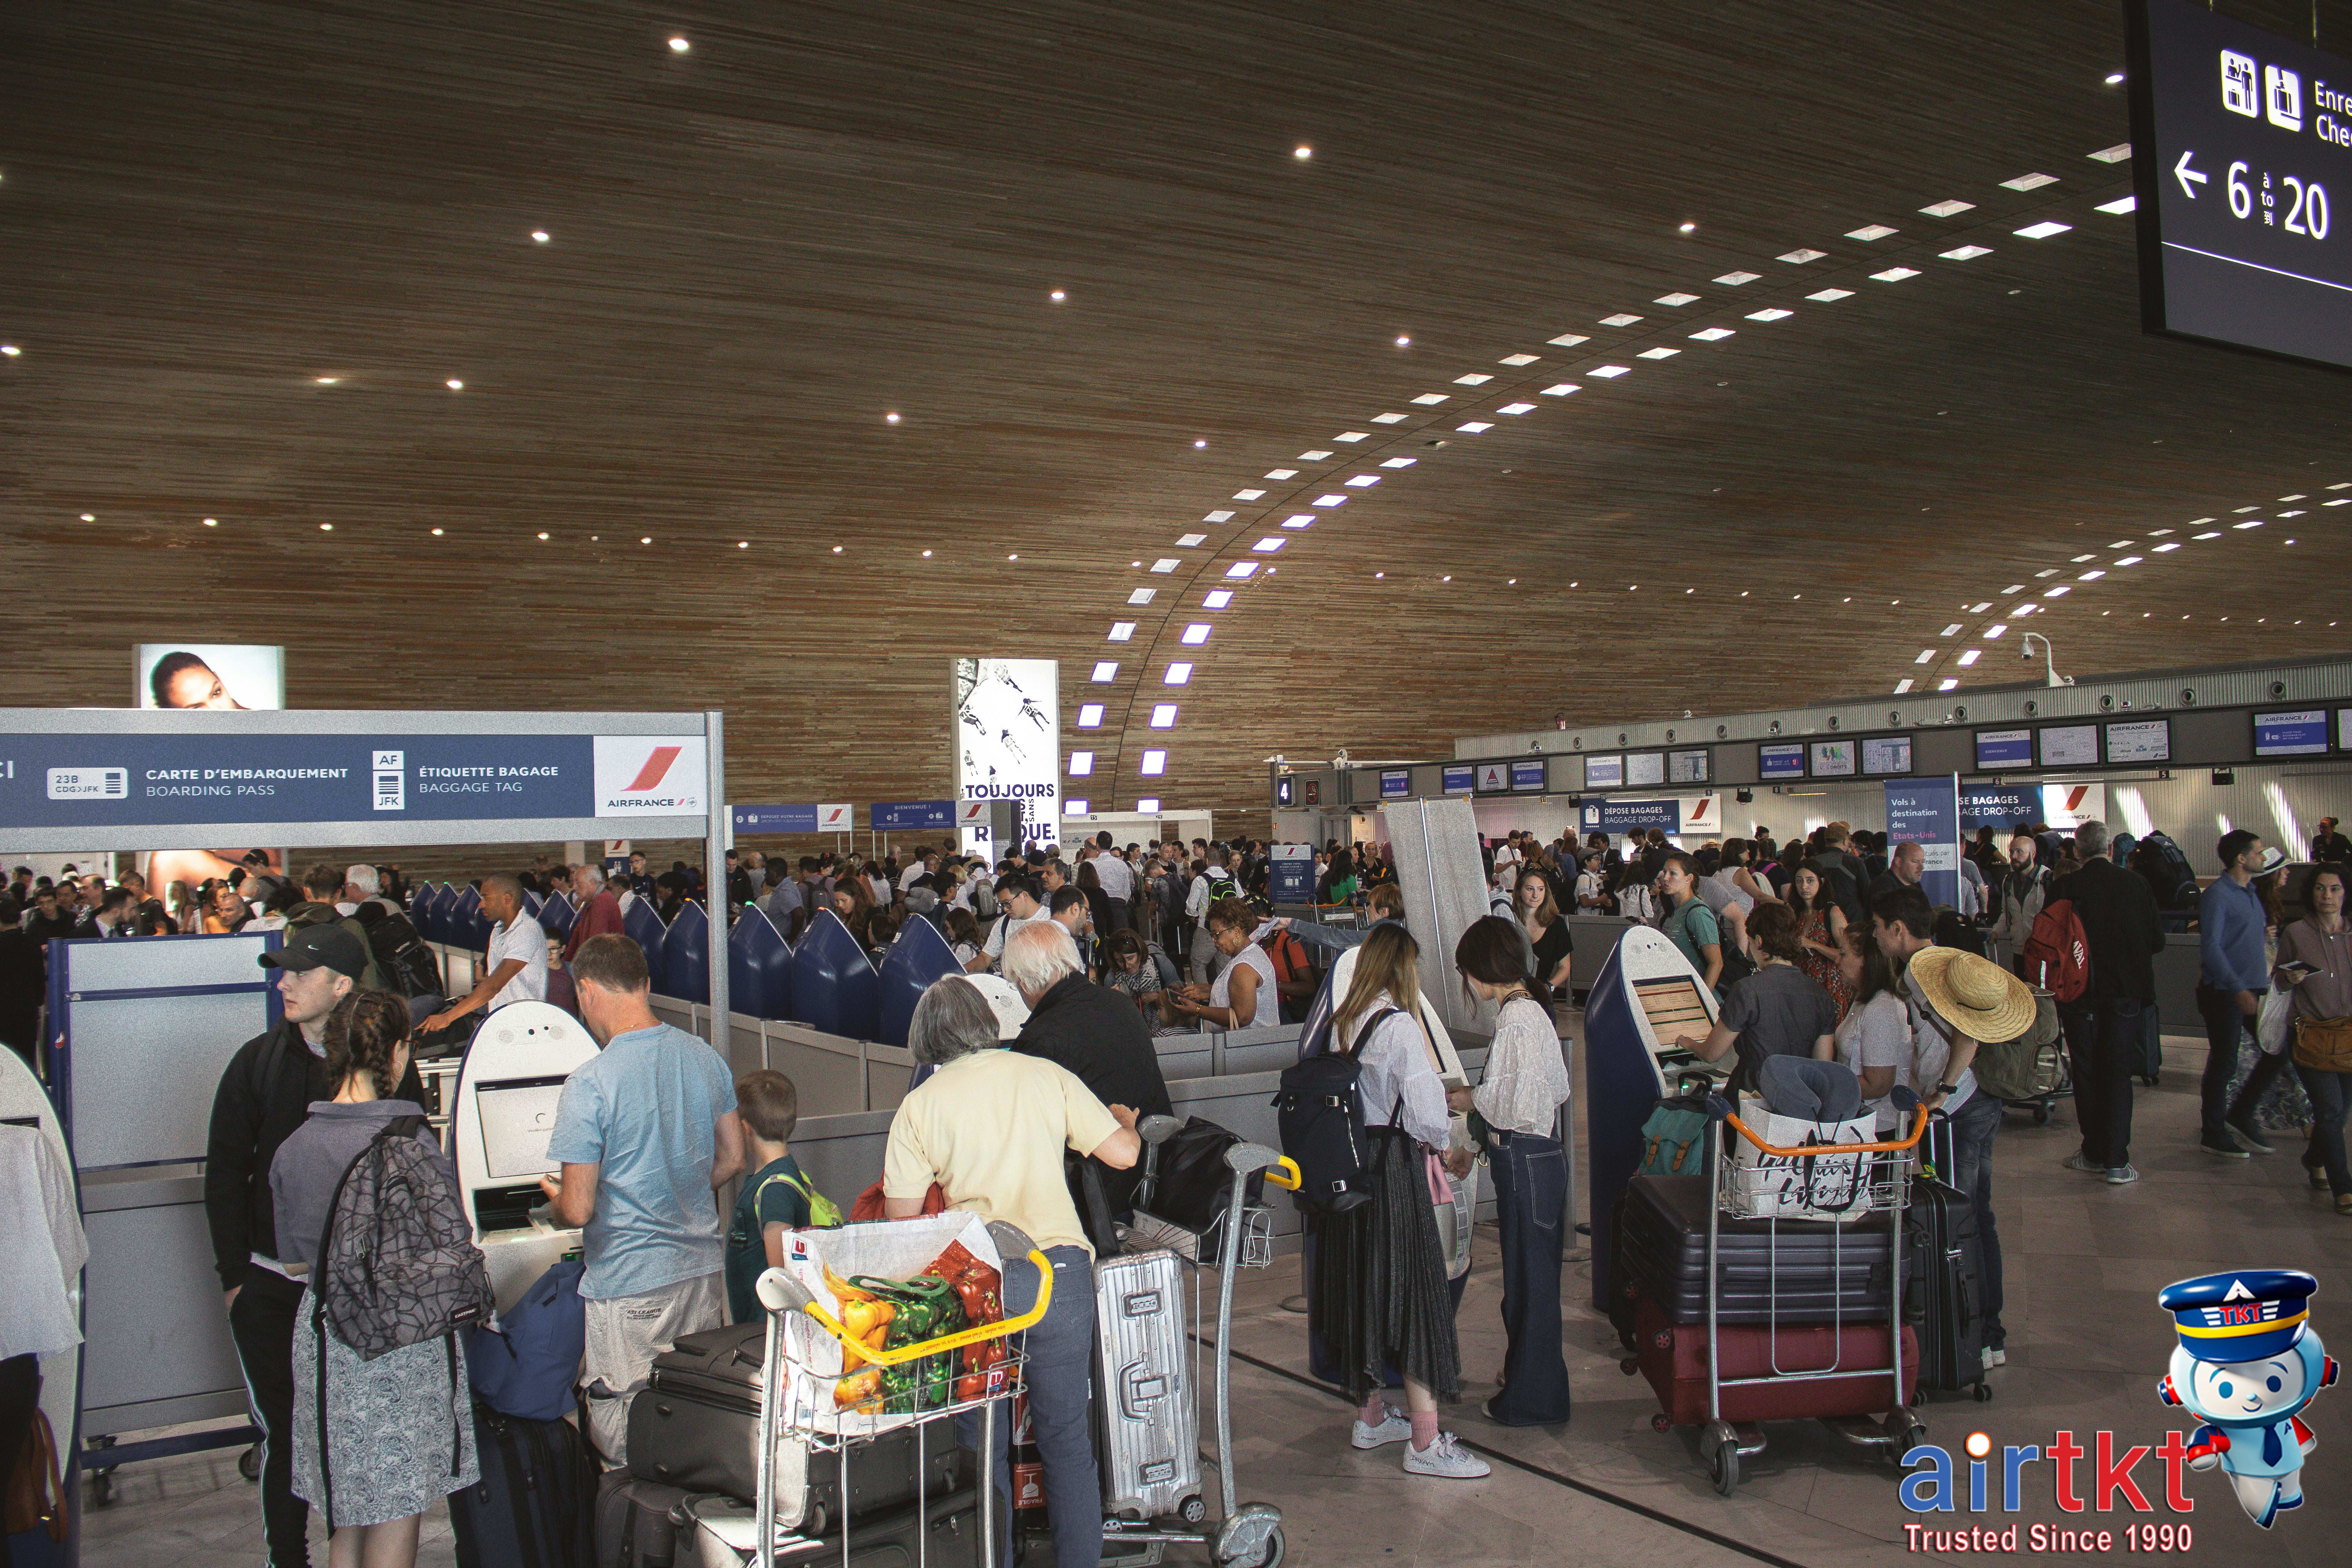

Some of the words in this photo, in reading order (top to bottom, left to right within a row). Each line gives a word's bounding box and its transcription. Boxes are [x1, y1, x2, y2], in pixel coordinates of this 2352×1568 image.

[2316, 115, 2352, 147] Che
[2228, 161, 2251, 219] 6
[2263, 172, 2270, 189] à
[2283, 177, 2328, 240] 20
[2261, 191, 2274, 207] to
[379, 755, 397, 765] AF
[146, 769, 199, 780] CARTE
[204, 768, 348, 780] D'EMBARQUEMENT
[419, 766, 494, 777] ÉTIQUETTE
[499, 766, 559, 777] BAGAGE
[55, 775, 78, 784] 23B
[147, 785, 232, 797] BOARDING
[238, 785, 275, 796] PASS
[419, 782, 490, 793] BAGGAGE
[495, 782, 523, 792] TAG
[965, 784, 1054, 798] TOUJOURS
[1281, 783, 1288, 800] 4
[379, 797, 399, 806] JFK
[608, 799, 675, 807] AIRFRANCE
[1973, 796, 2019, 804] BAGAGES
[1604, 806, 1629, 815] DÉPOSE
[1891, 808, 1938, 817] destination
[1983, 806, 2031, 816] DROP-OFF
[1893, 831, 1937, 840] Etats-Unis
[455, 1308, 476, 1319] EASTPAK
[1412, 1454, 1435, 1467] DREAM
